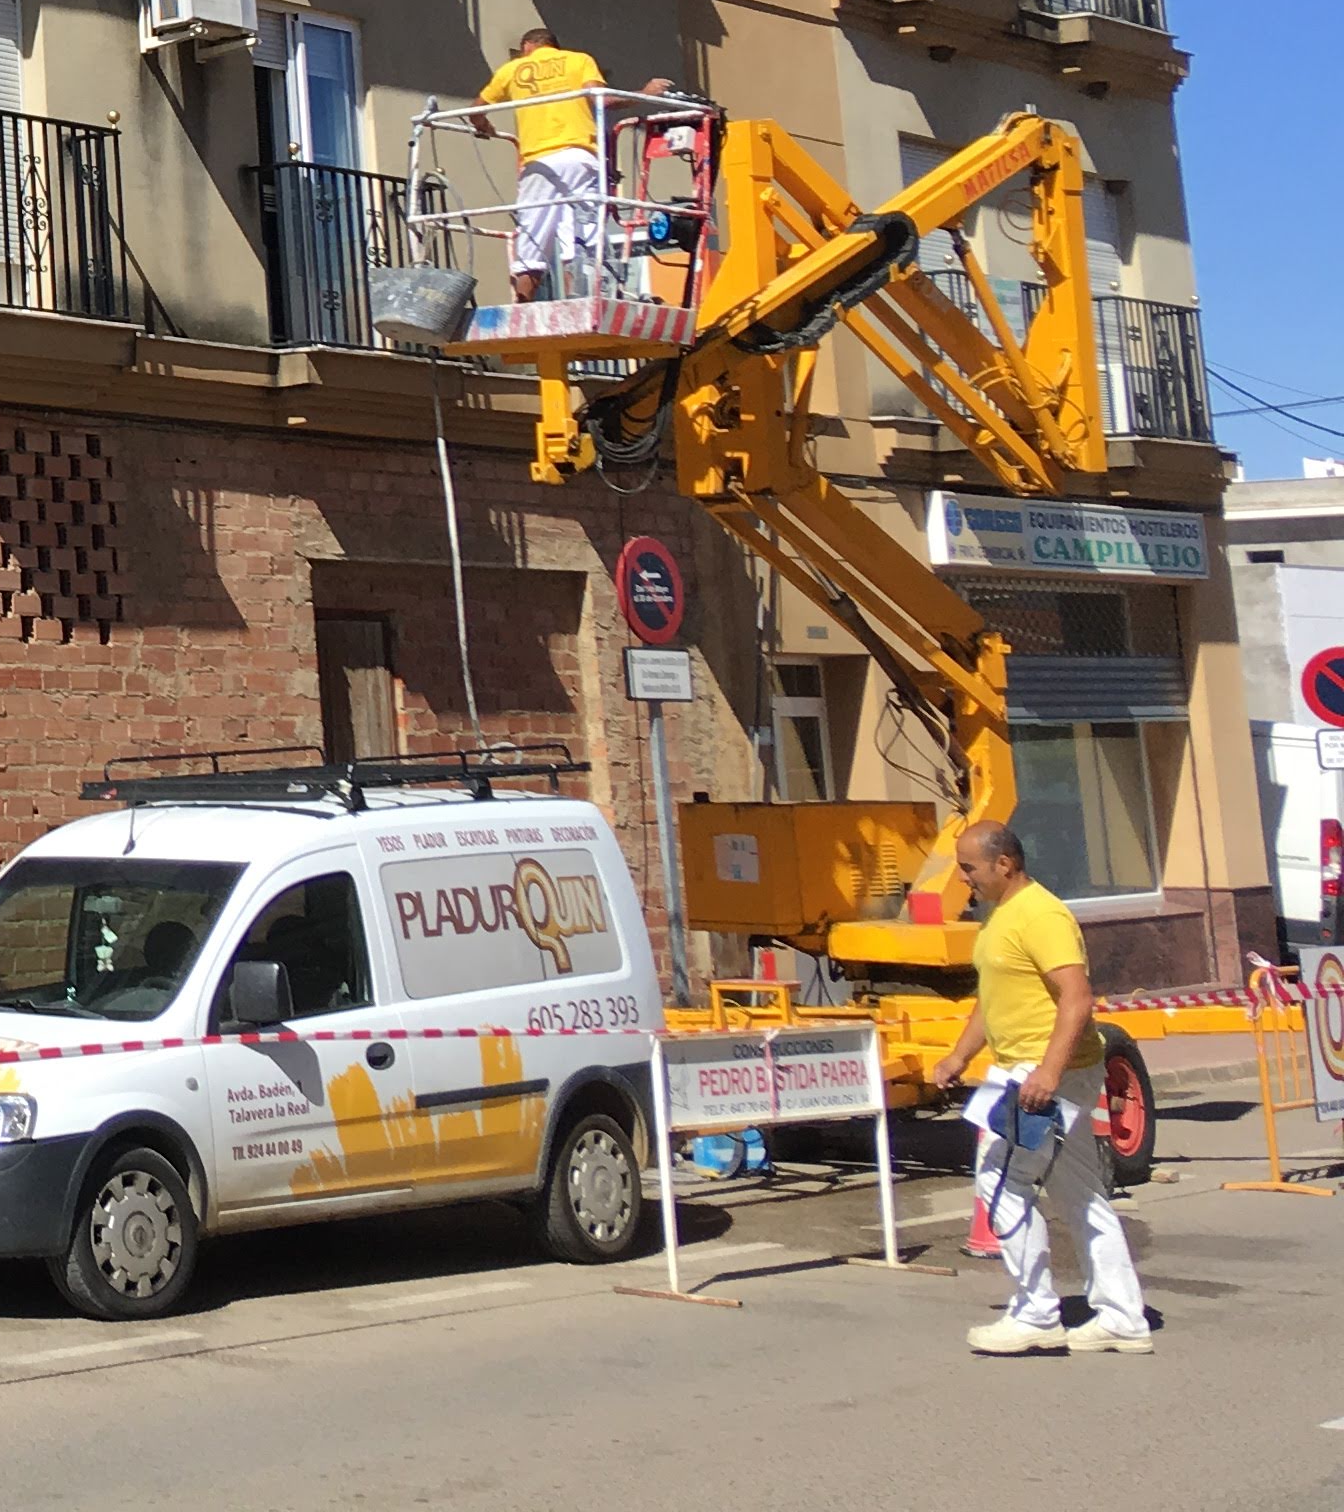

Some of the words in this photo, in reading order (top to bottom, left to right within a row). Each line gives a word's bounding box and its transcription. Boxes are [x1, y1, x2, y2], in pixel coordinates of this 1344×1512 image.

[1029, 511, 1126, 535] EQUIPAMIENTOS
[1128, 519, 1199, 539] HOSTELEROS
[1034, 535, 1201, 568] CAMPILLEJO
[376, 835, 406, 853] YESOS
[413, 832, 448, 849] PLADUR
[454, 829, 499, 847] ESCAYOLAS
[504, 828, 544, 844] PINTURAS
[528, 1003, 565, 1030] 605
[567, 999, 604, 1030] 283
[606, 995, 639, 1027] 393
[733, 1039, 834, 1059] CONSRUCCIONES
[698, 1066, 752, 1097] PEDRO
[756, 1063, 820, 1095] BSTIDA
[821, 1059, 869, 1089] PARRA
[227, 1086, 257, 1103] Avda.
[228, 1106, 274, 1124] Talavera
[276, 1103, 285, 1117] la
[287, 1097, 310, 1116] Real
[247, 1143, 264, 1159] 924
